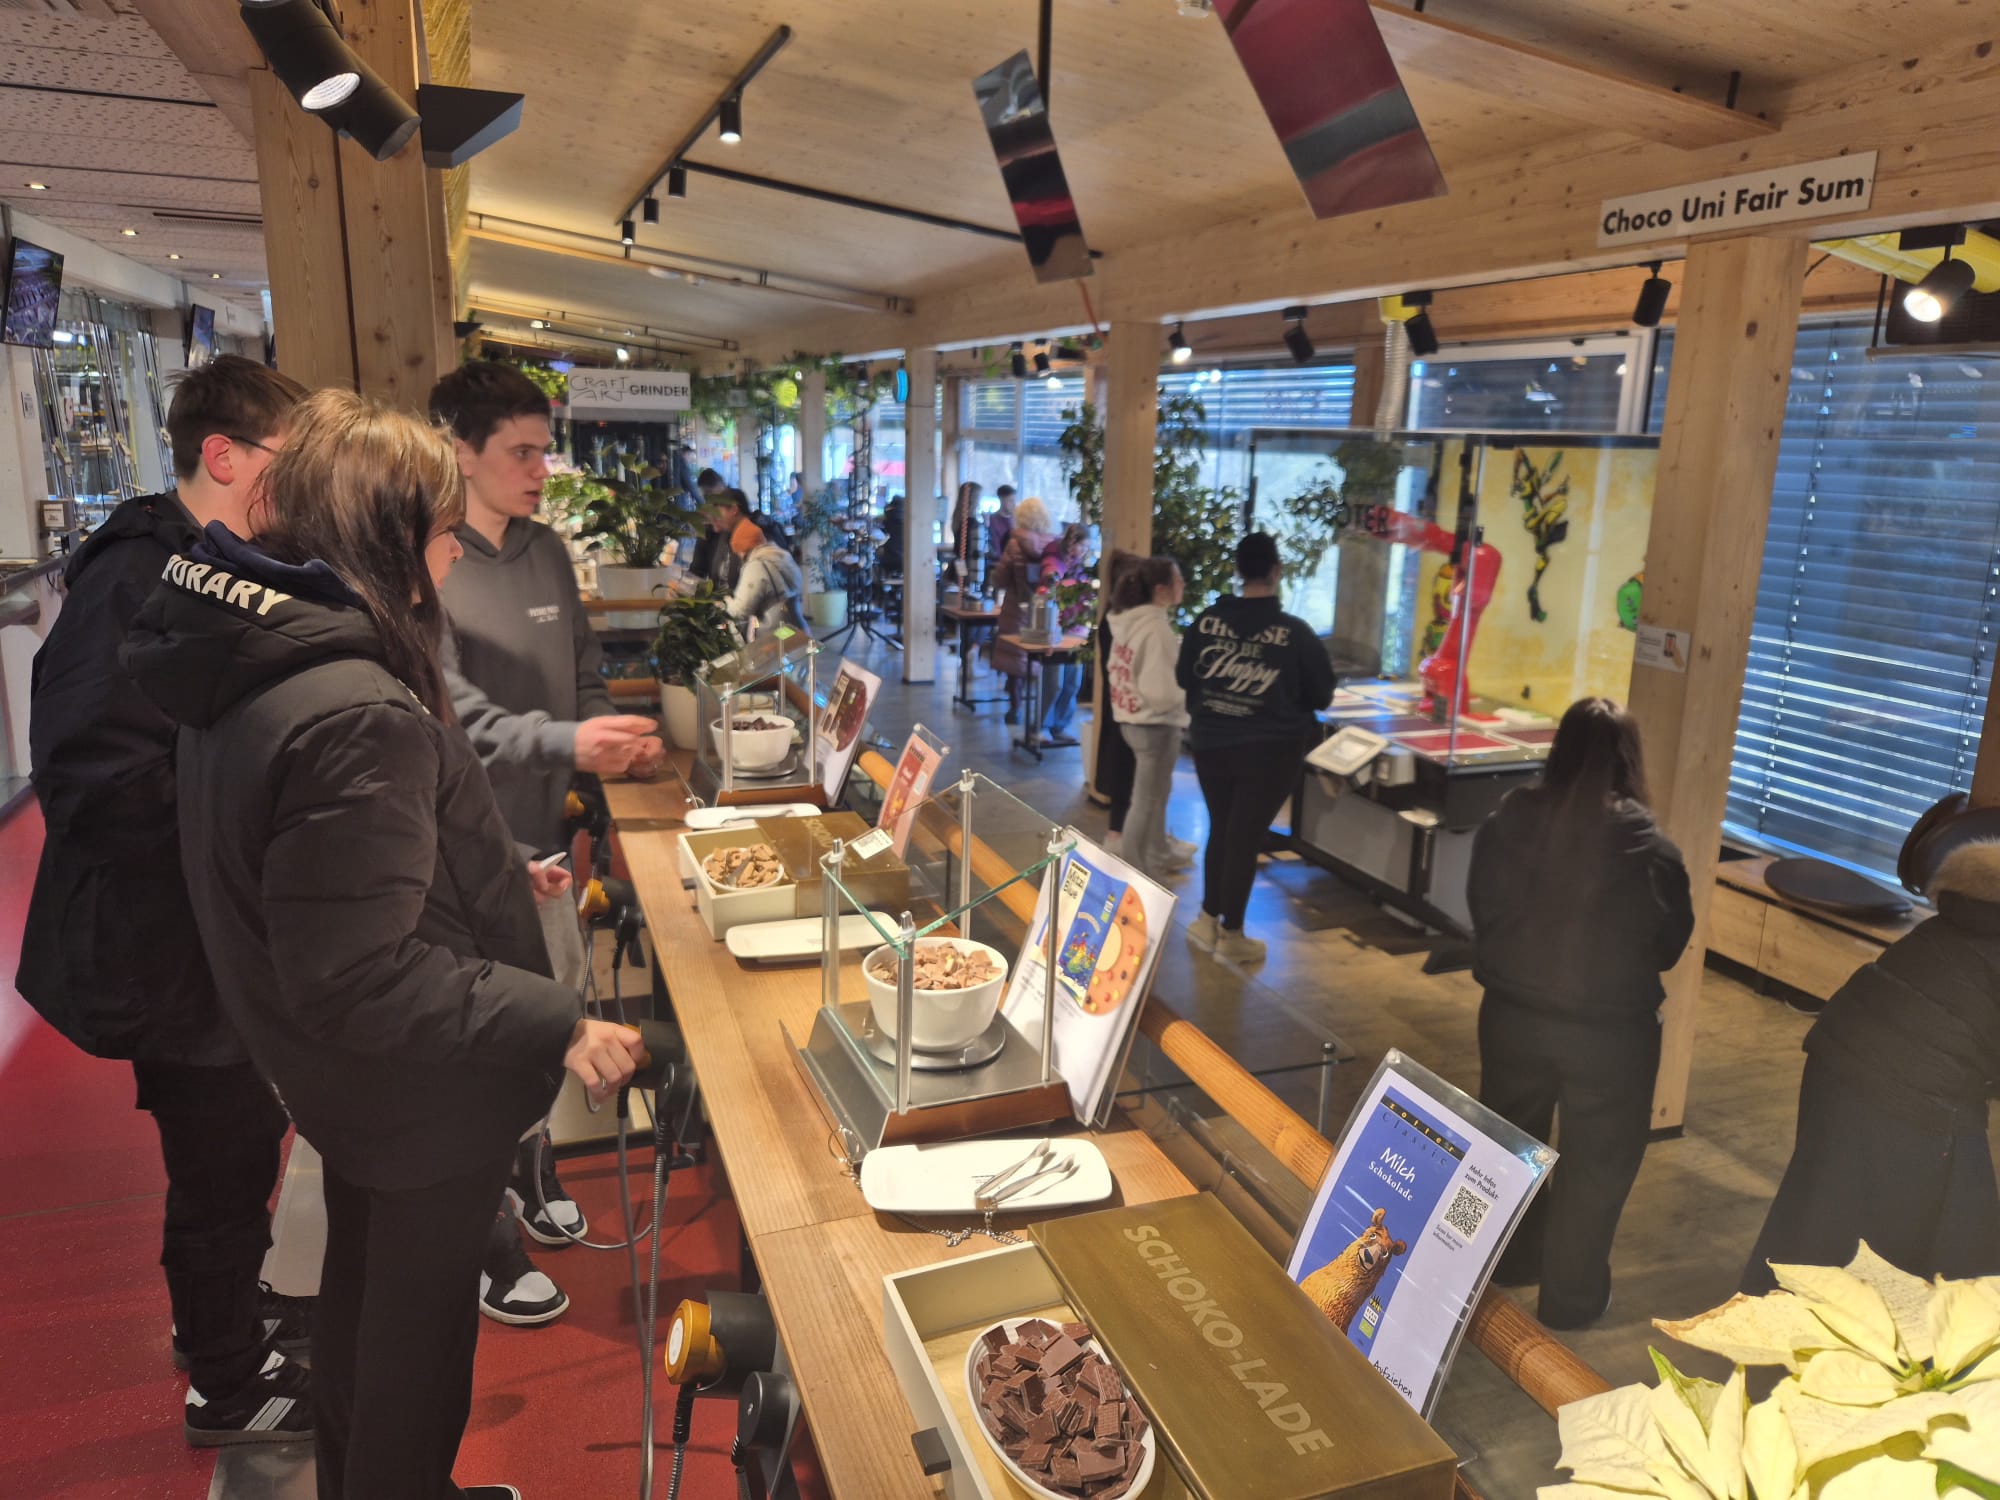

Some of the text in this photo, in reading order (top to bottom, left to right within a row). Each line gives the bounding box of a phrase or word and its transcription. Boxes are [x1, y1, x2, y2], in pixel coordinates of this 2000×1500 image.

[1603, 176, 1865, 236] Choco Uni Fair Sum
[629, 384, 689, 397] GRINDER
[1199, 616, 1291, 647] CHSE
[1196, 645, 1281, 696] Happy
[1389, 1103, 1455, 1152] zotter
[1368, 1160, 1413, 1201] Schokolade
[1380, 1147, 1415, 1183] Milch
[1469, 1164, 1497, 1189] Mehr Infos
[1123, 1224, 1335, 1456] SCHOKO-LADE
